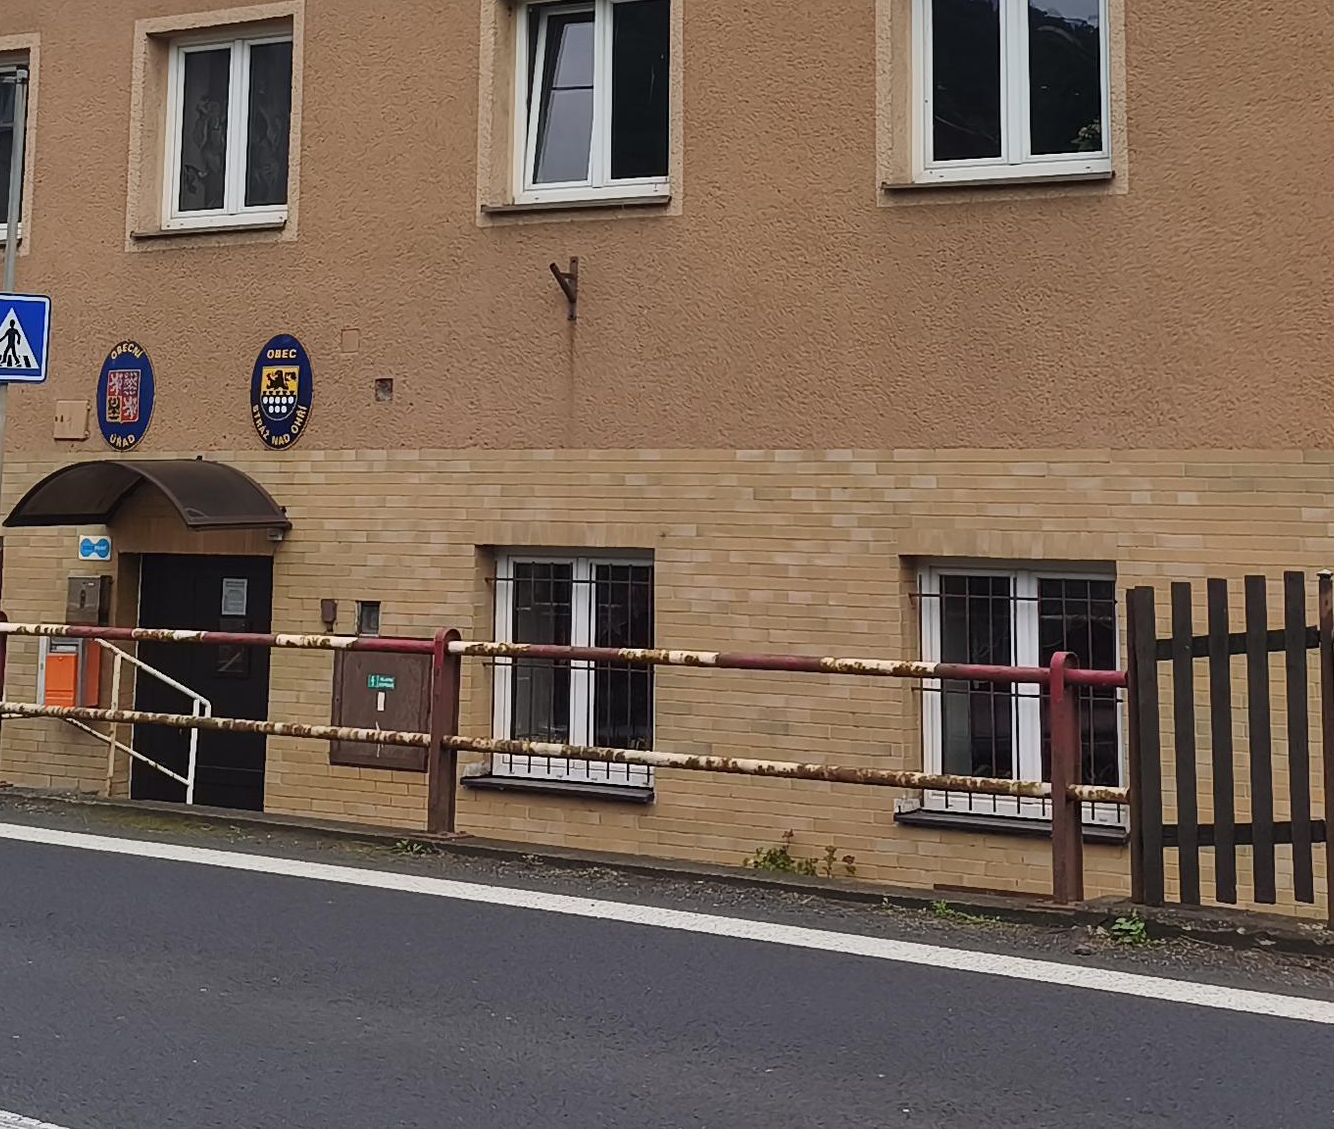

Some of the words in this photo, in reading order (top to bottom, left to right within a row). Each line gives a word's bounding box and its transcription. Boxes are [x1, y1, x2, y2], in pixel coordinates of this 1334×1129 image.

[111, 343, 143, 359] OBECNÍ
[267, 349, 297, 359] OBEC
[252, 404, 270, 440] STRÁŽ
[271, 433, 291, 446] NAD
[290, 404, 308, 434] OHŘÍ
[110, 433, 136, 447] ÚŘAD
